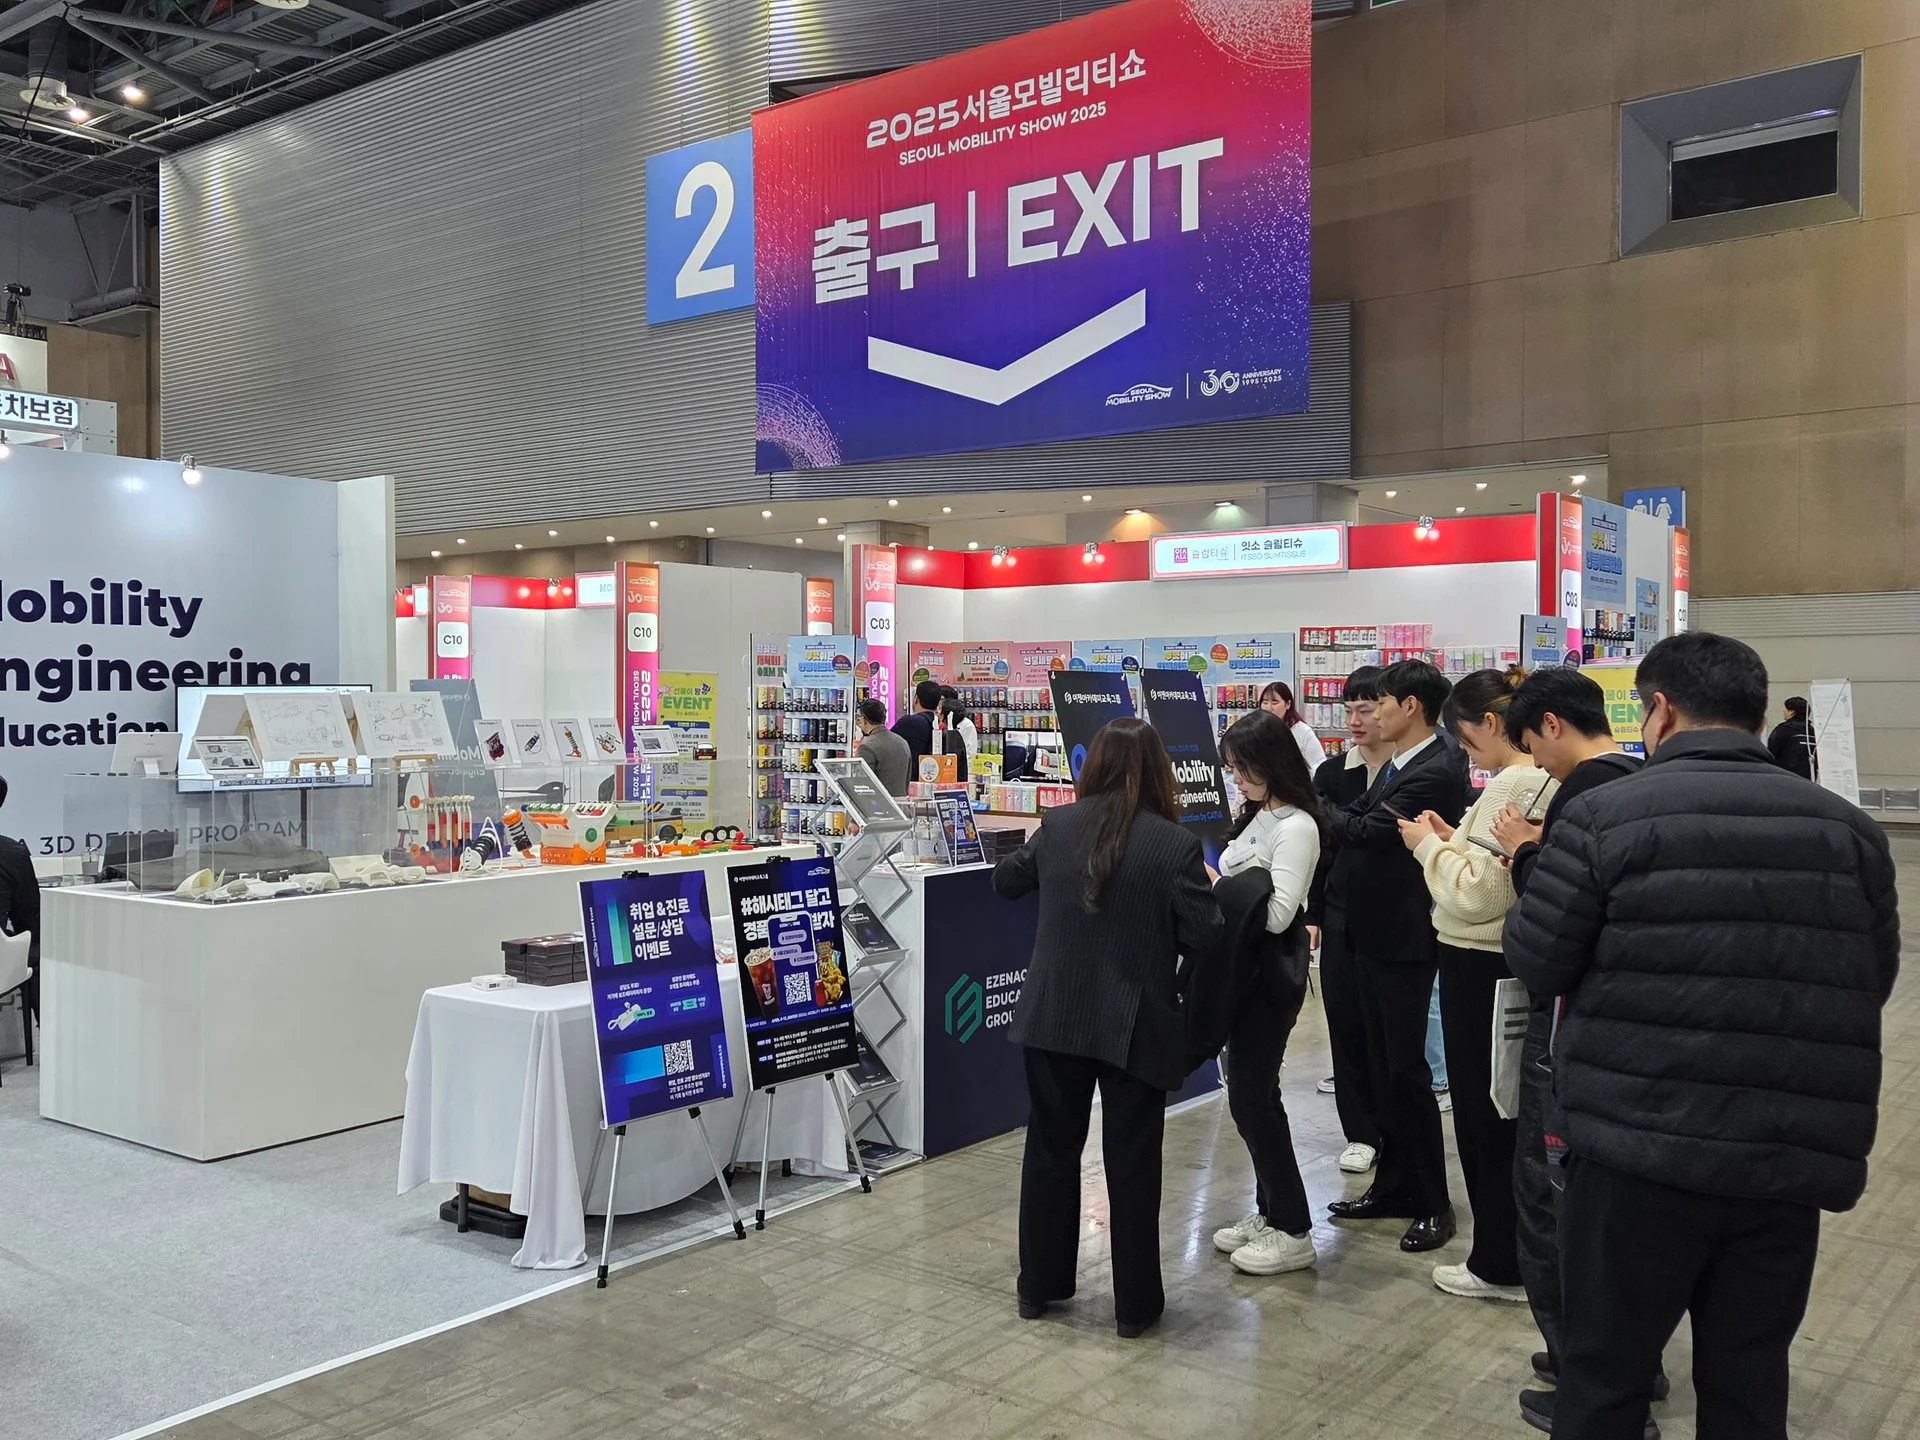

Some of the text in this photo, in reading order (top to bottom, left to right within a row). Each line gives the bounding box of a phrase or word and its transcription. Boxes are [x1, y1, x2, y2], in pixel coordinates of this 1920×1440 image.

[866, 48, 1147, 150] 2025서울모빌리티쇼
[899, 101, 1107, 166] SEOUL MOBILITY SHOW 2025
[1006, 137, 1225, 268] EXIT
[674, 161, 735, 300] 2
[810, 201, 940, 305] 출구
[1241, 368, 1282, 380] ANNIVERSARY
[0, 393, 73, 425] 차보험
[1105, 390, 1172, 407] MOBILITY SHOW
[1241, 538, 1303, 551] 잇소 슬림티슈
[0, 577, 203, 638] obility
[633, 627, 652, 639] C10
[870, 617, 891, 630] C03
[443, 635, 463, 645] C10
[0, 643, 311, 703] ngineering
[662, 695, 712, 710] EVENT
[1624, 743, 1634, 751] 01
[1172, 788, 1221, 808] gineering
[39, 836, 75, 855] 3D
[630, 900, 655, 921] 취업
[740, 887, 832, 916] #해시태그 달고
[632, 918, 684, 941] 설문/상담
[634, 940, 671, 961] 이벤트
